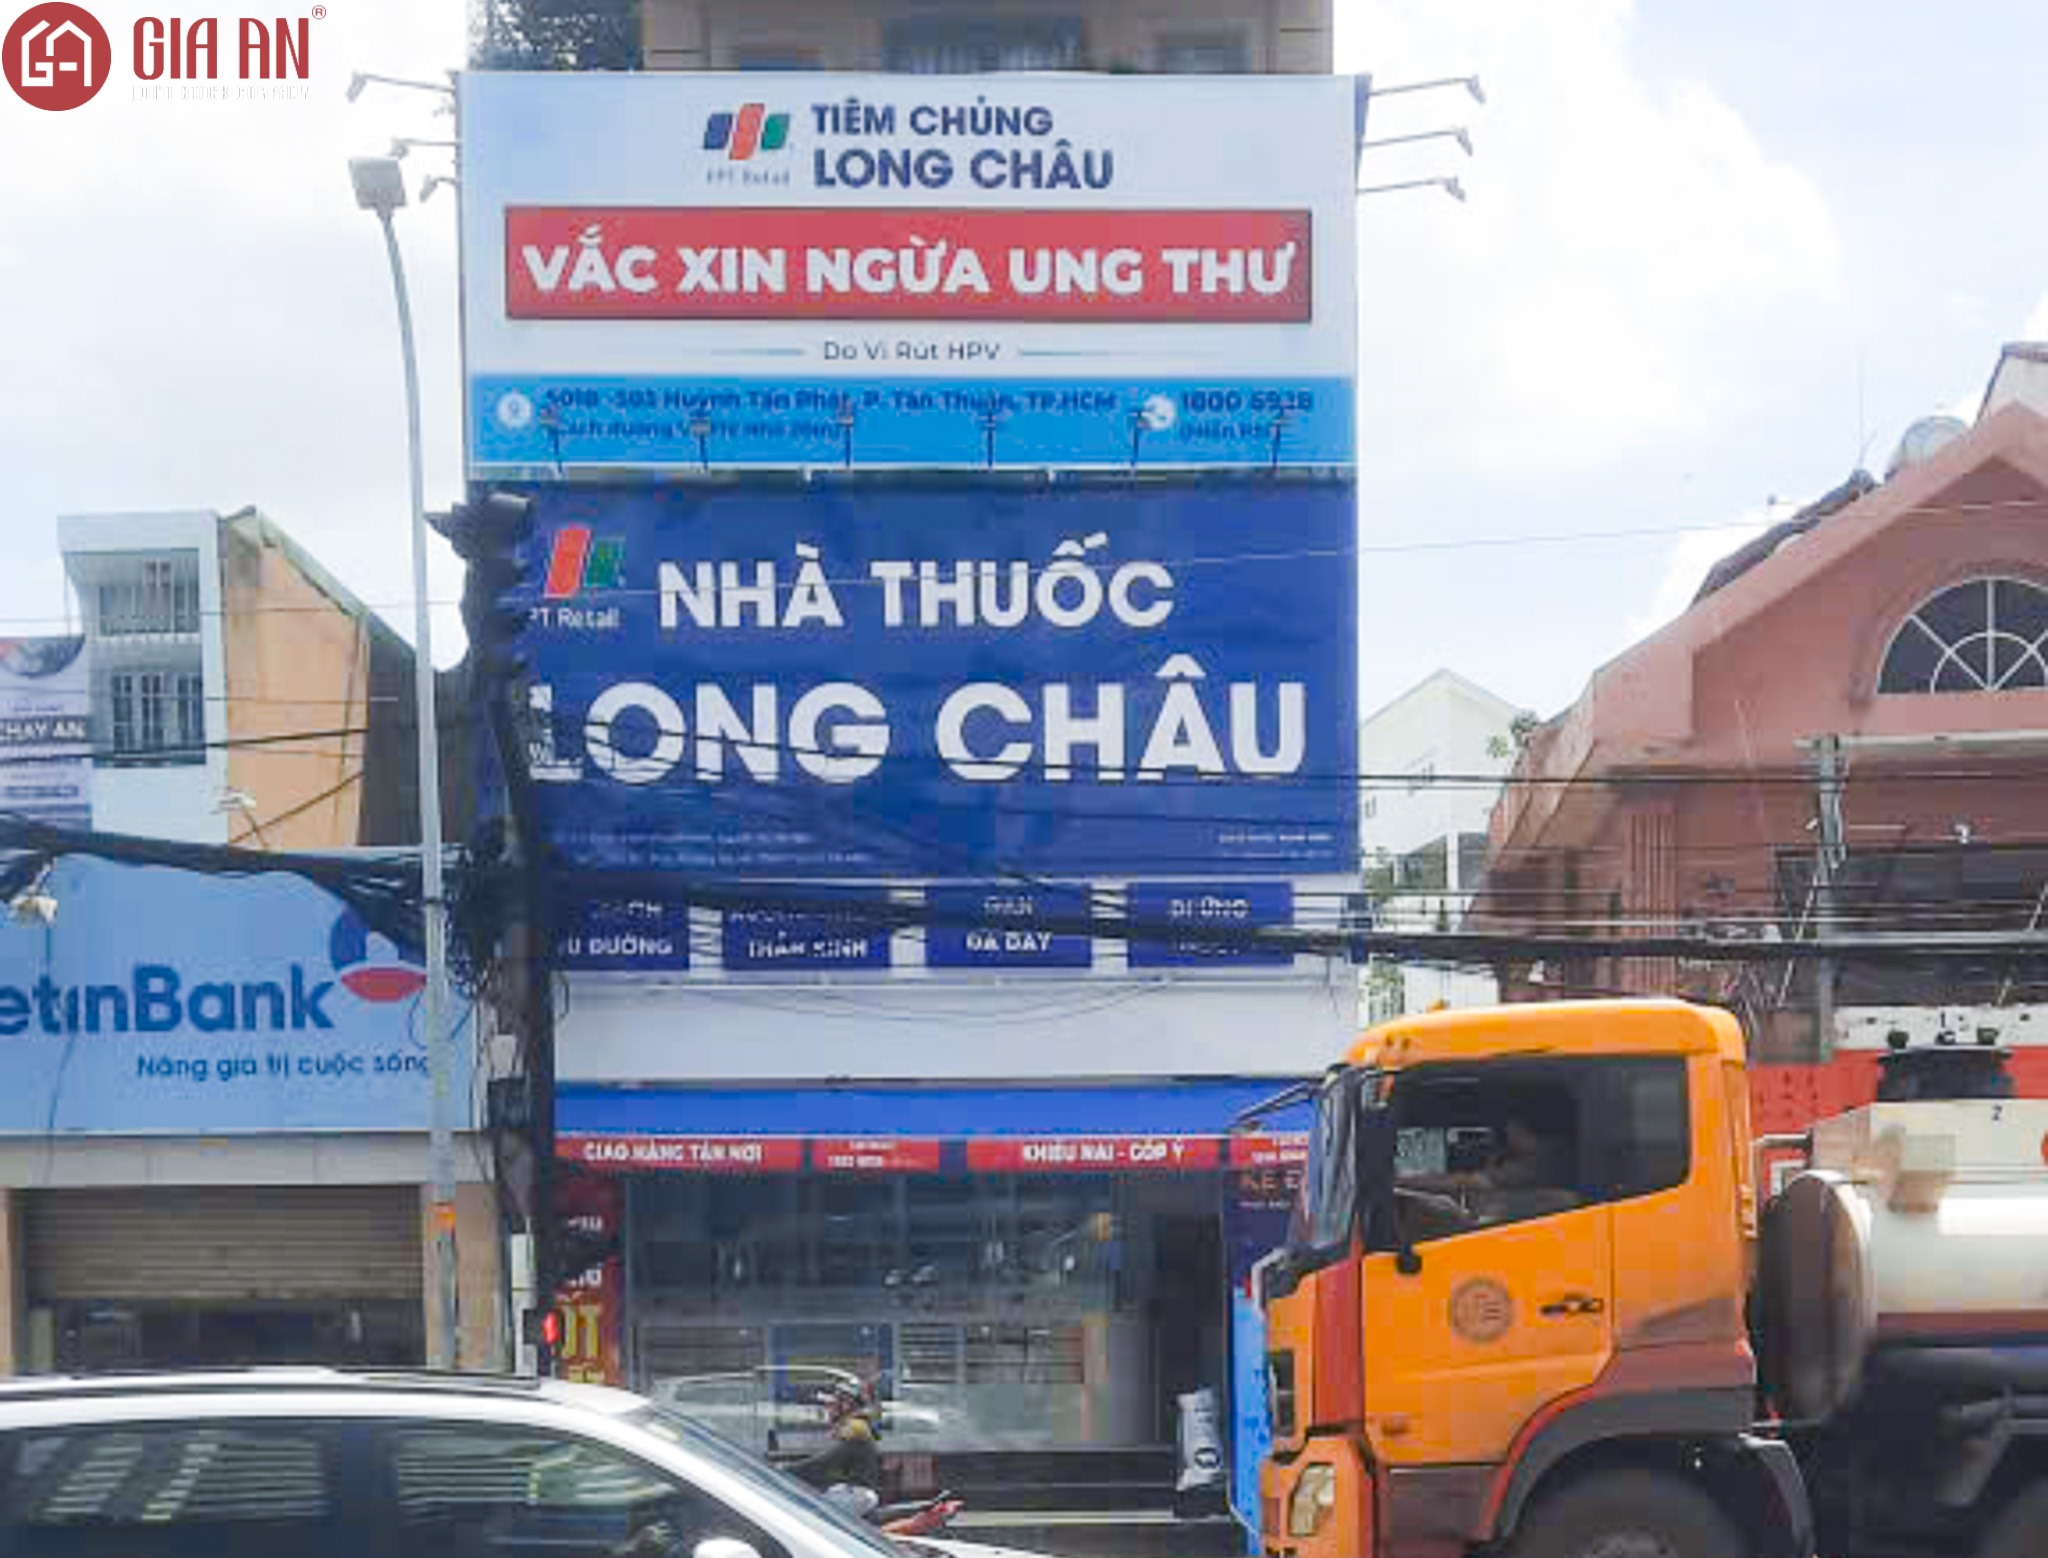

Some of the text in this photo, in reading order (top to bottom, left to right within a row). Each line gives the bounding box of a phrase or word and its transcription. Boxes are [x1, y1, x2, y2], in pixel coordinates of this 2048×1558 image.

[811, 96, 897, 136] TIÊM
[814, 139, 1113, 189] LONG CHÂU
[521, 225, 1296, 295] VẮC XIN NGỪA UNG THƯ
[823, 341, 855, 362] Do
[864, 341, 889, 362] Vi
[948, 342, 1001, 362] HPV
[660, 532, 1174, 628] NHÀ THUỐC
[935, 655, 1305, 782] CHÂU
[137, 1053, 207, 1081] Nâng
